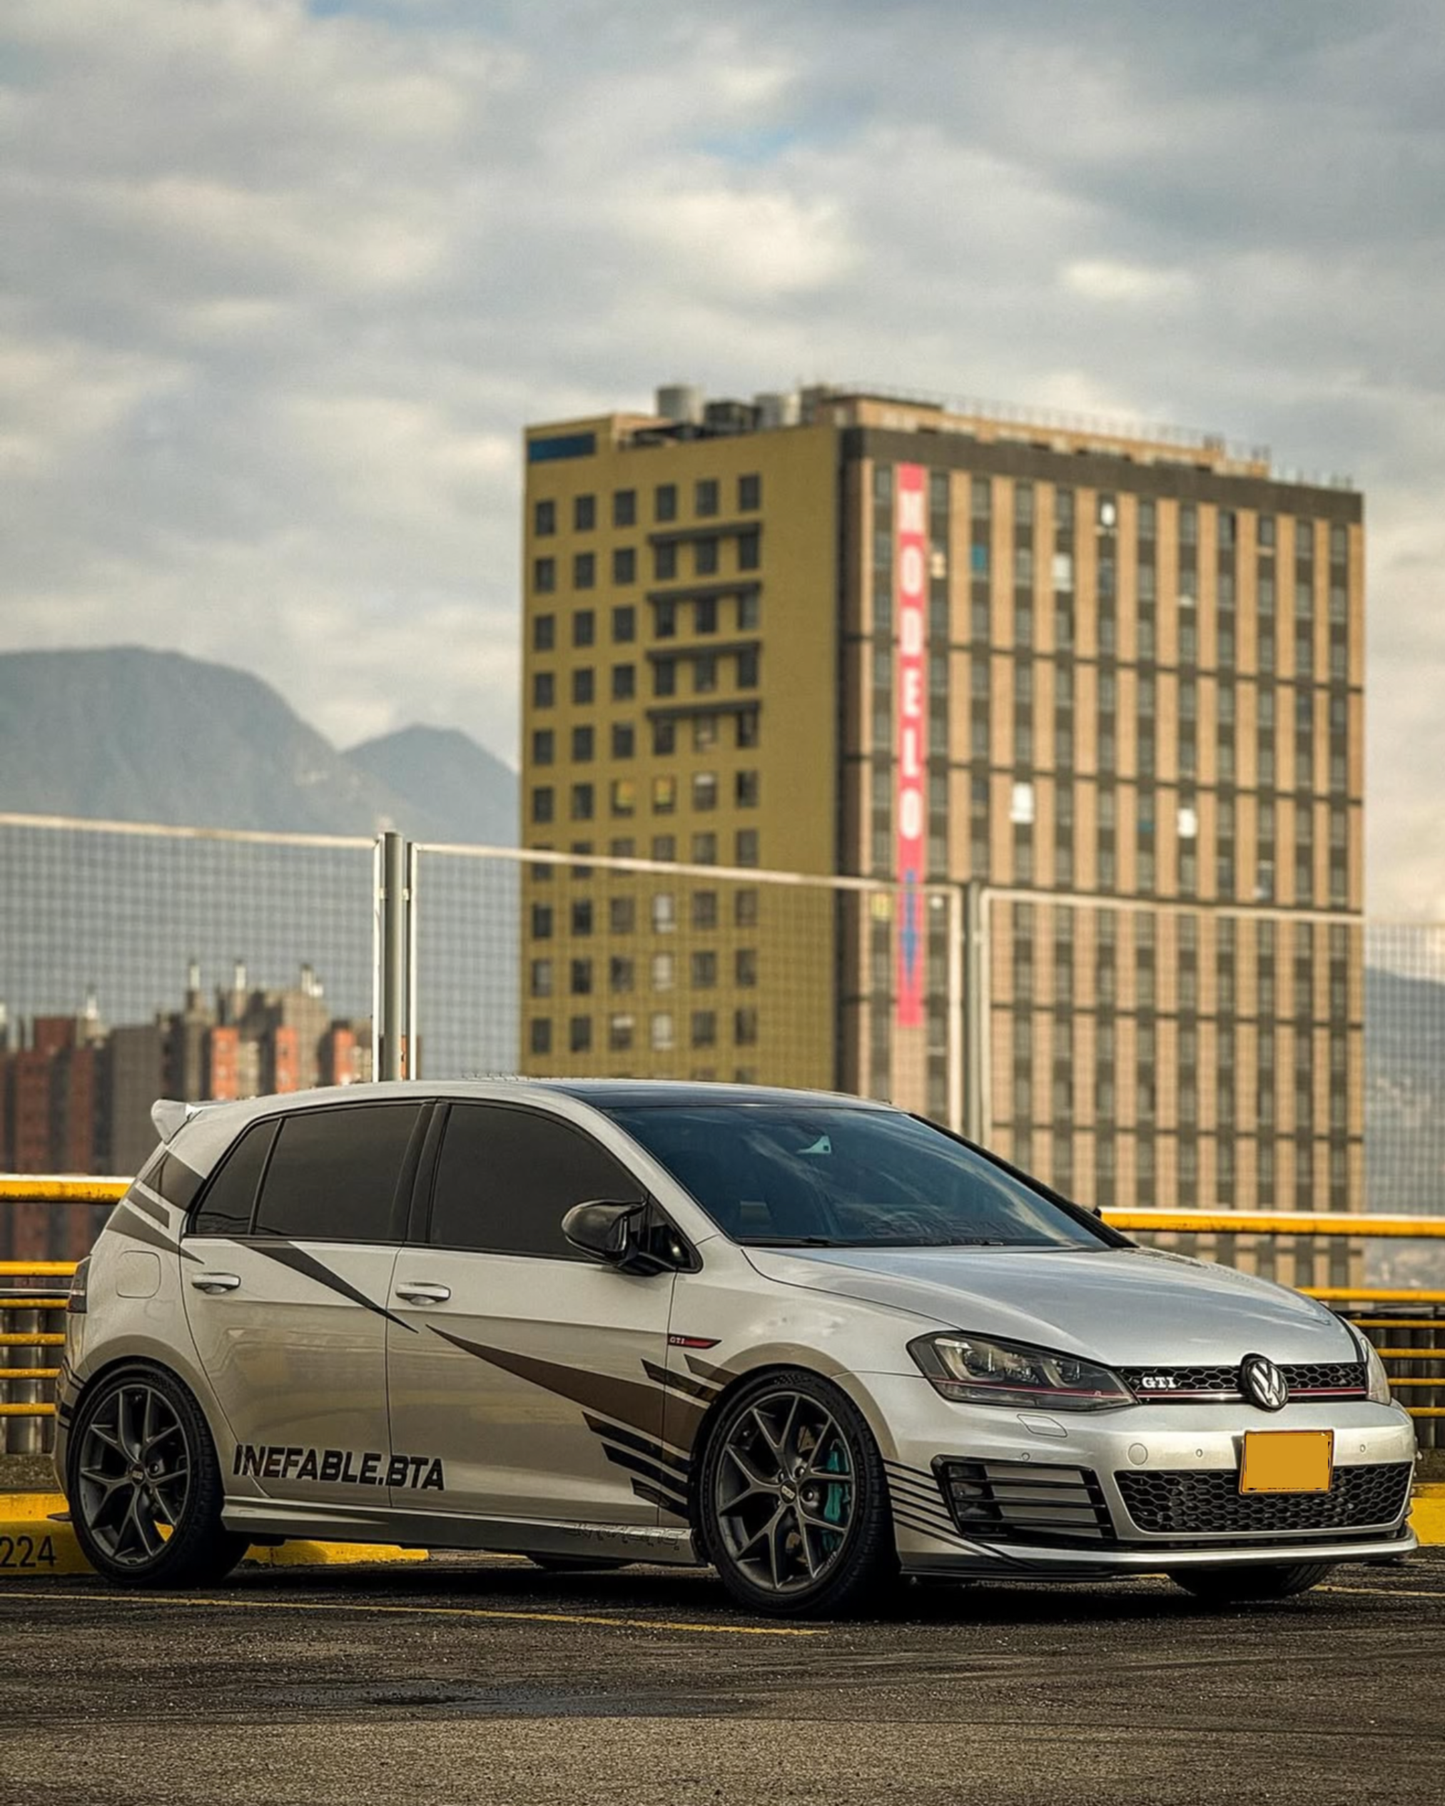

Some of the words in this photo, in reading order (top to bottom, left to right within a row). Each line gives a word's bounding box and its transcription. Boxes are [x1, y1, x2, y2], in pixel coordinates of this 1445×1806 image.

[900, 490, 924, 840] MODELO
[669, 1336, 686, 1345] GTI
[1142, 1376, 1177, 1389] GTI
[233, 1444, 444, 1491] INEFABLE.BTA
[0, 1535, 56, 1568] 224
